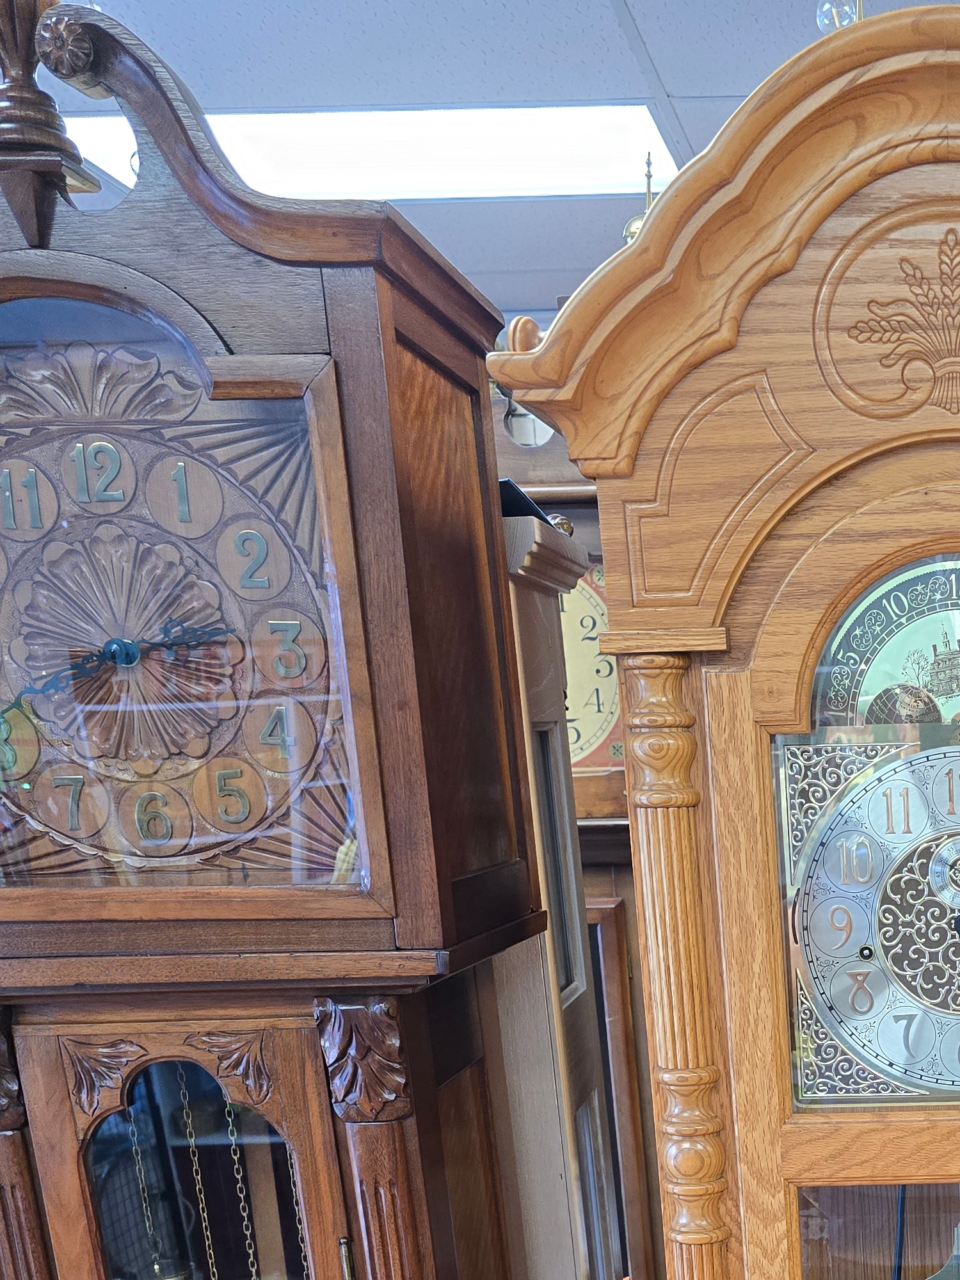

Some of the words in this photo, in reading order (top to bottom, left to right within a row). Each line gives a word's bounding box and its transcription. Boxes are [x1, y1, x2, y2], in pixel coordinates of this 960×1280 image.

[70, 441, 125, 503] 12
[172, 462, 191, 523] 1
[0, 469, 43, 529] 11
[234, 529, 270, 589] 2
[580, 615, 598, 642] 2
[882, 591, 908, 621] 10
[268, 620, 306, 678] 3
[593, 653, 614, 678] 3
[837, 649, 860, 669] 5
[583, 688, 604, 713] 4
[824, 709, 847, 718] 1
[259, 706, 296, 759] 4
[52, 775, 85, 831] 7
[135, 792, 173, 846] 6
[216, 769, 249, 823] 5
[882, 787, 913, 835] 11
[836, 837, 874, 886] 10
[828, 905, 853, 950] 9
[846, 970, 874, 1015] 8
[892, 1014, 918, 1058] 7
